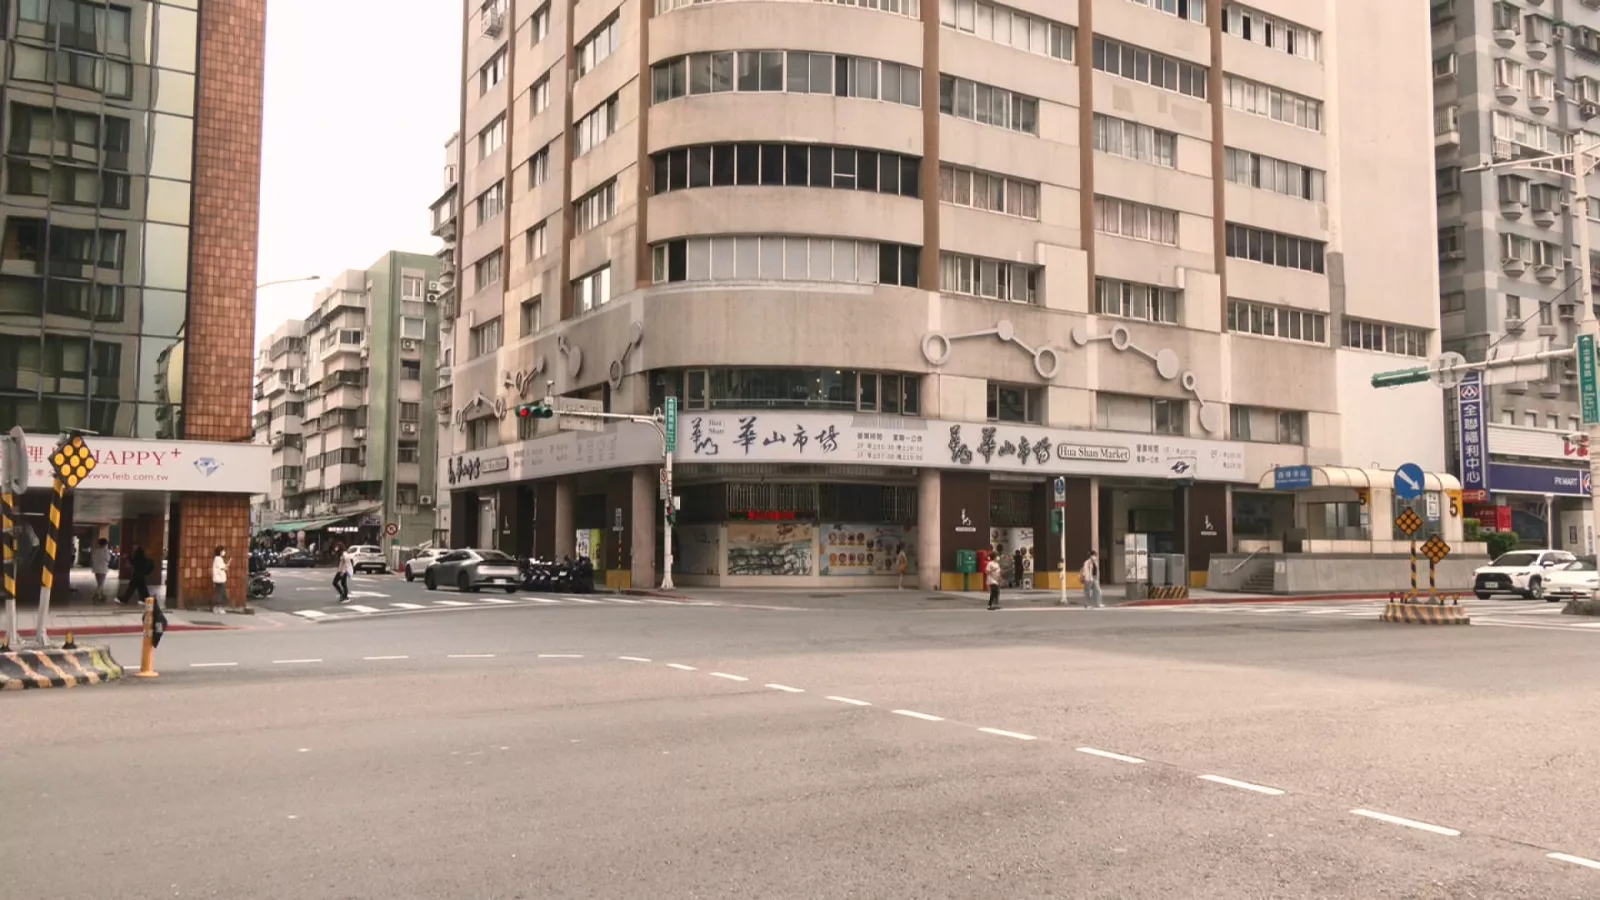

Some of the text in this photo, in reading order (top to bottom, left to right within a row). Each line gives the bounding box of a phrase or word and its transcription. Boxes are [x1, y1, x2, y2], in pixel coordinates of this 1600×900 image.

[732, 415, 840, 455] 華山市場
[976, 426, 1052, 465] 華山市場
[1464, 404, 1480, 483] 全聯福利中心
[1060, 445, 1128, 460] Hua Shan Market
[1359, 492, 1367, 506] 5
[1449, 497, 1458, 517] 5
